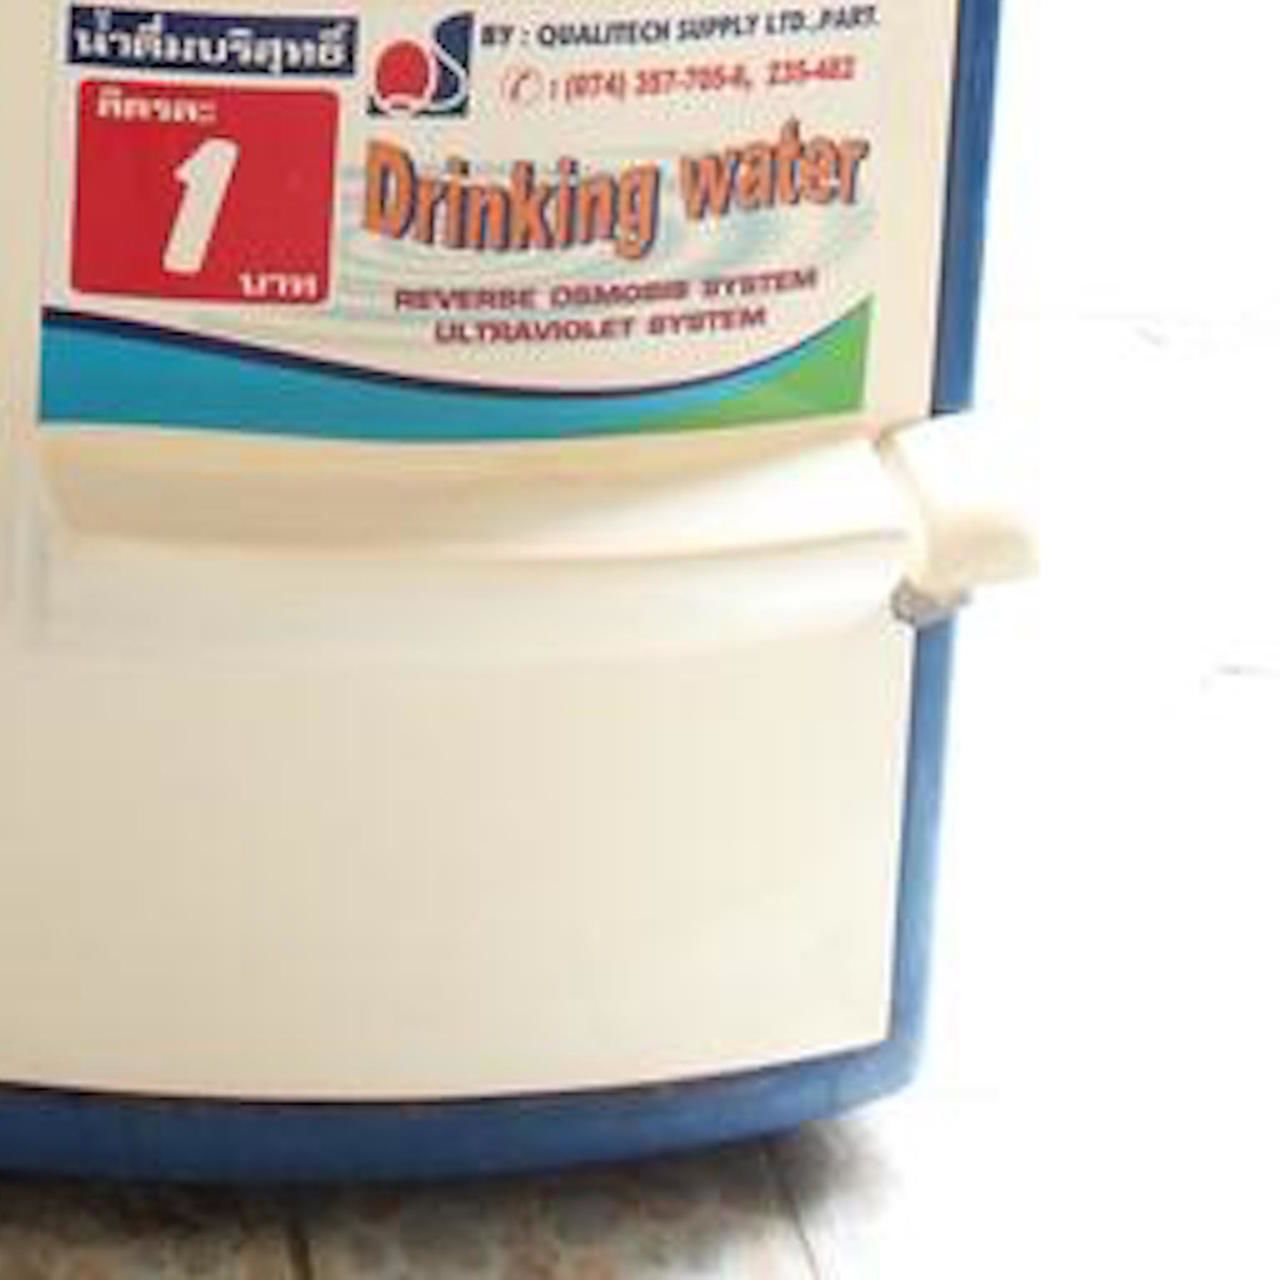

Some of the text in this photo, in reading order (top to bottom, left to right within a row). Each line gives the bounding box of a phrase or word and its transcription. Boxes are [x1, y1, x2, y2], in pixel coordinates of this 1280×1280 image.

[481, 23, 514, 46] BY
[537, 18, 671, 46] QUALITECH
[676, 13, 758, 41] SUPPLY
[163, 137, 241, 274] 1
[365, 116, 871, 261] Drinking water
[238, 271, 319, 299] บาท
[395, 269, 818, 311] REVERSE OSMOSIS SYSTEM
[435, 307, 767, 344] ULTRAVIOLET SYSTEM
